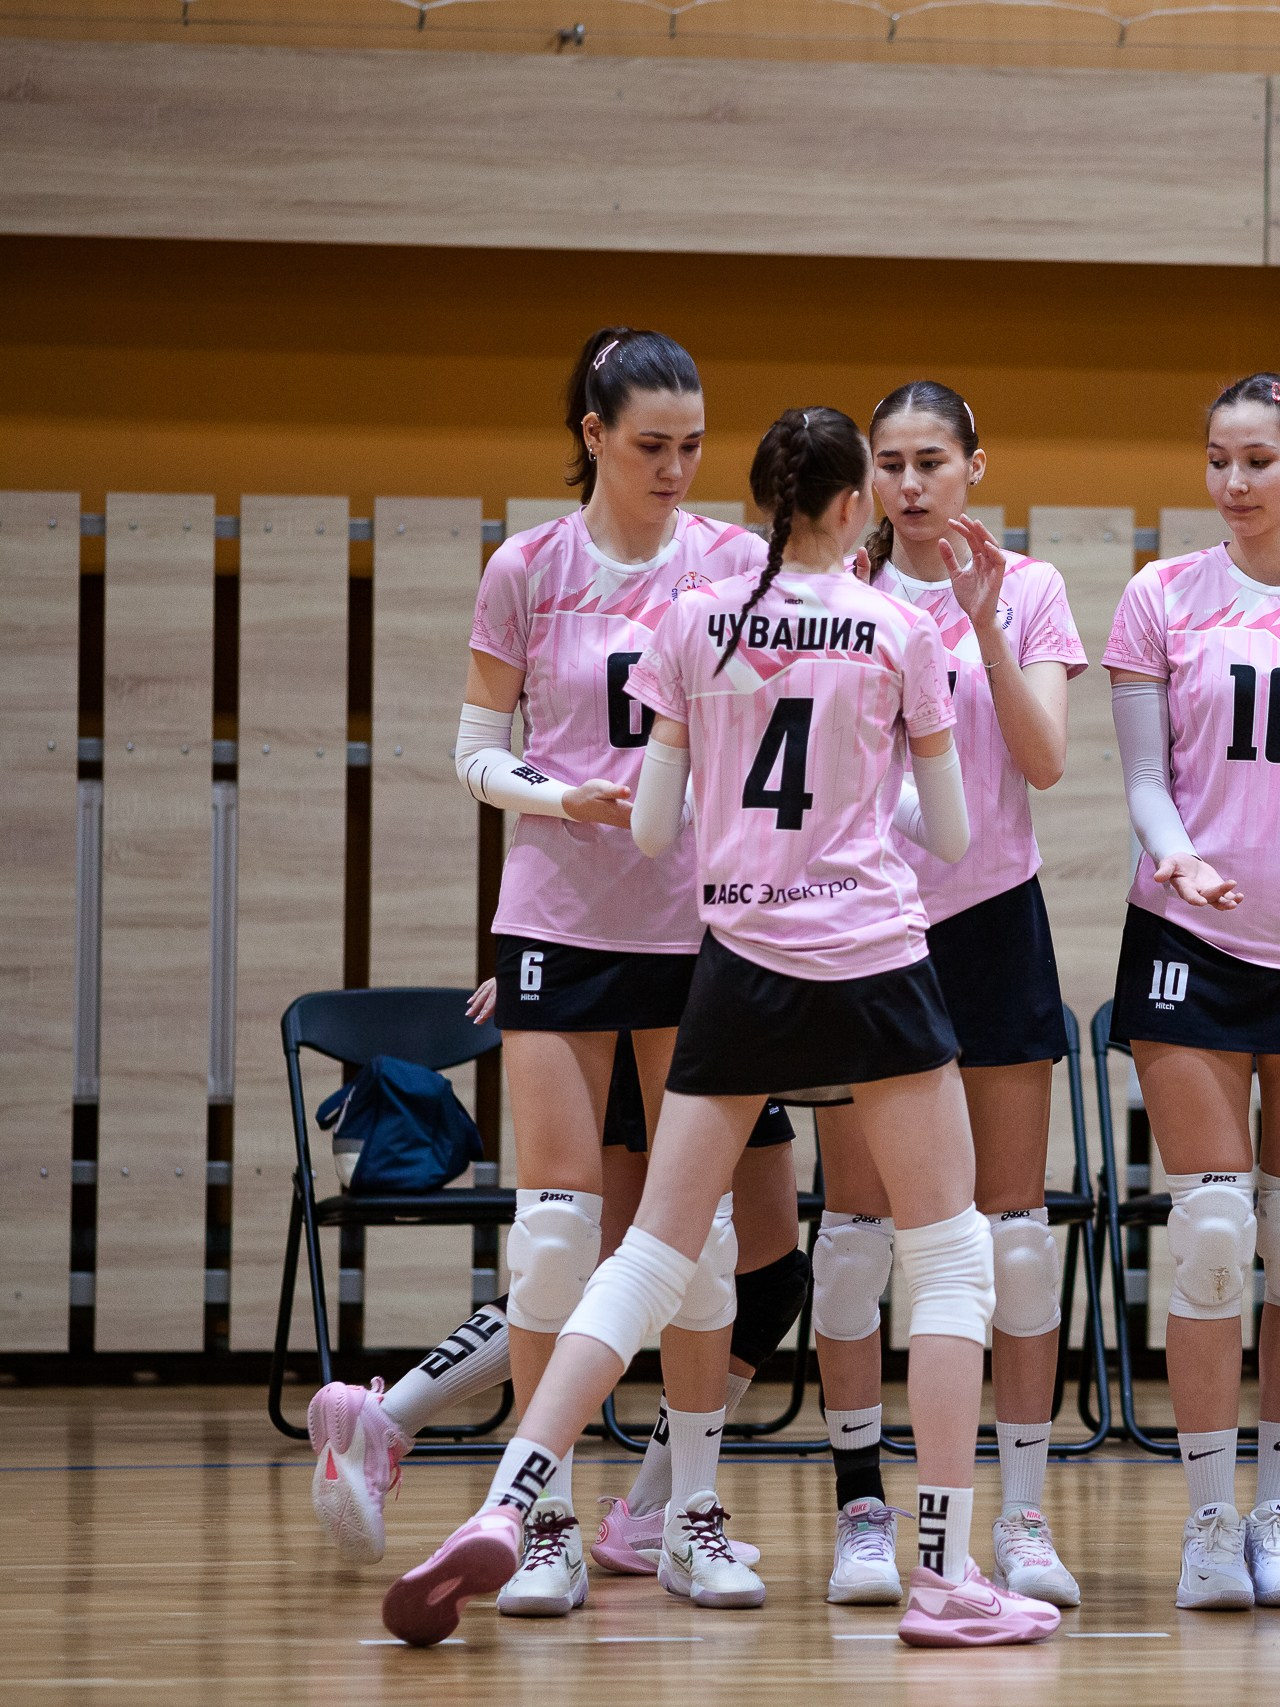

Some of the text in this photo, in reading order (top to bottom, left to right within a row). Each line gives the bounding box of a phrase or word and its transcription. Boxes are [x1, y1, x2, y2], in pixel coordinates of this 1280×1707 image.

[707, 613, 877, 655] ЧУВАШИЯ
[741, 697, 815, 831] 4
[717, 877, 858, 905] АБС Электро
[520, 950, 544, 991] 6
[1148, 959, 1189, 1002] 10
[520, 993, 540, 1001] Hitch
[1155, 1001, 1175, 1011] Hitch
[1213, 1174, 1238, 1183] asics
[548, 1192, 575, 1202] asics
[1203, 1507, 1218, 1518] NIKE
